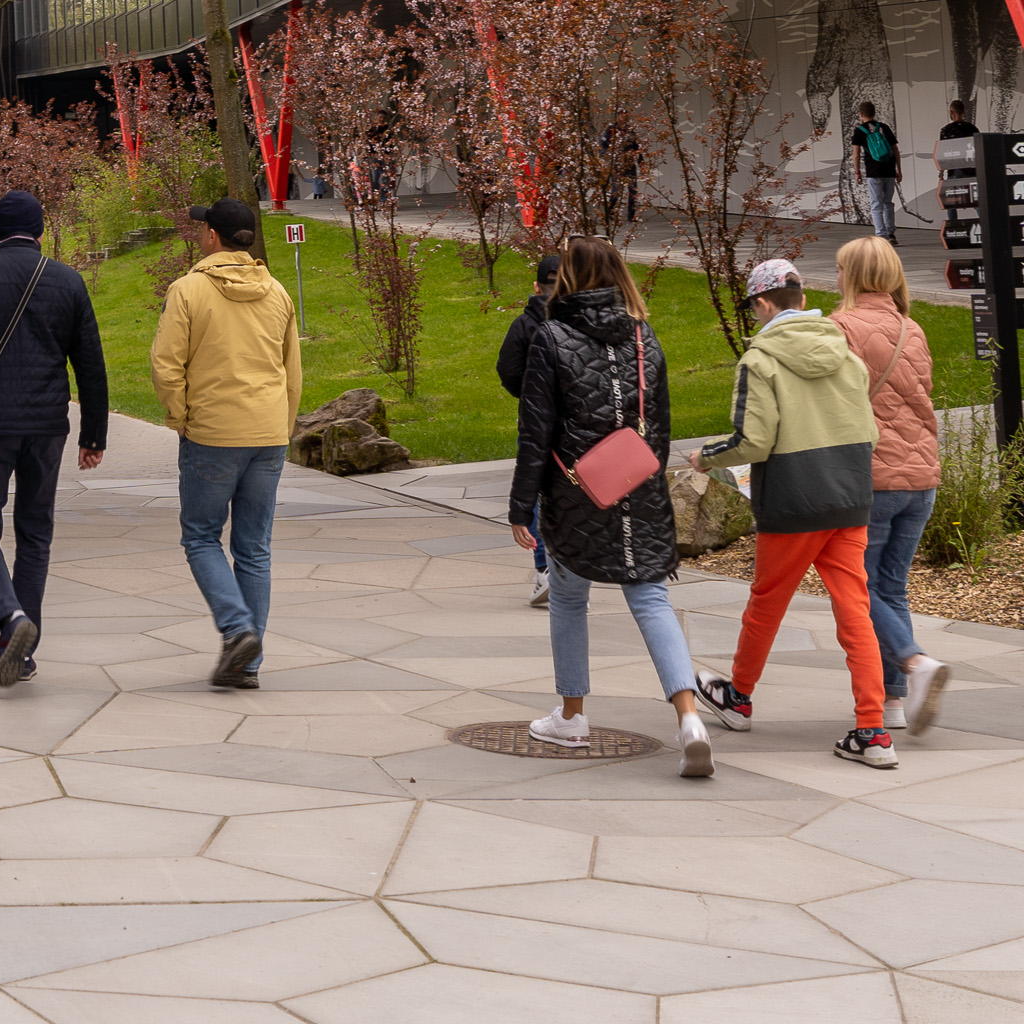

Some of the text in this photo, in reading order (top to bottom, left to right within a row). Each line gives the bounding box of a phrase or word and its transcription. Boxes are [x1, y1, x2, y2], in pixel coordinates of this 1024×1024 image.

[291, 227, 300, 241] H
[611, 379, 622, 399] LOVE
[621, 516, 633, 537] LOVE
[624, 547, 635, 567] LOVE
